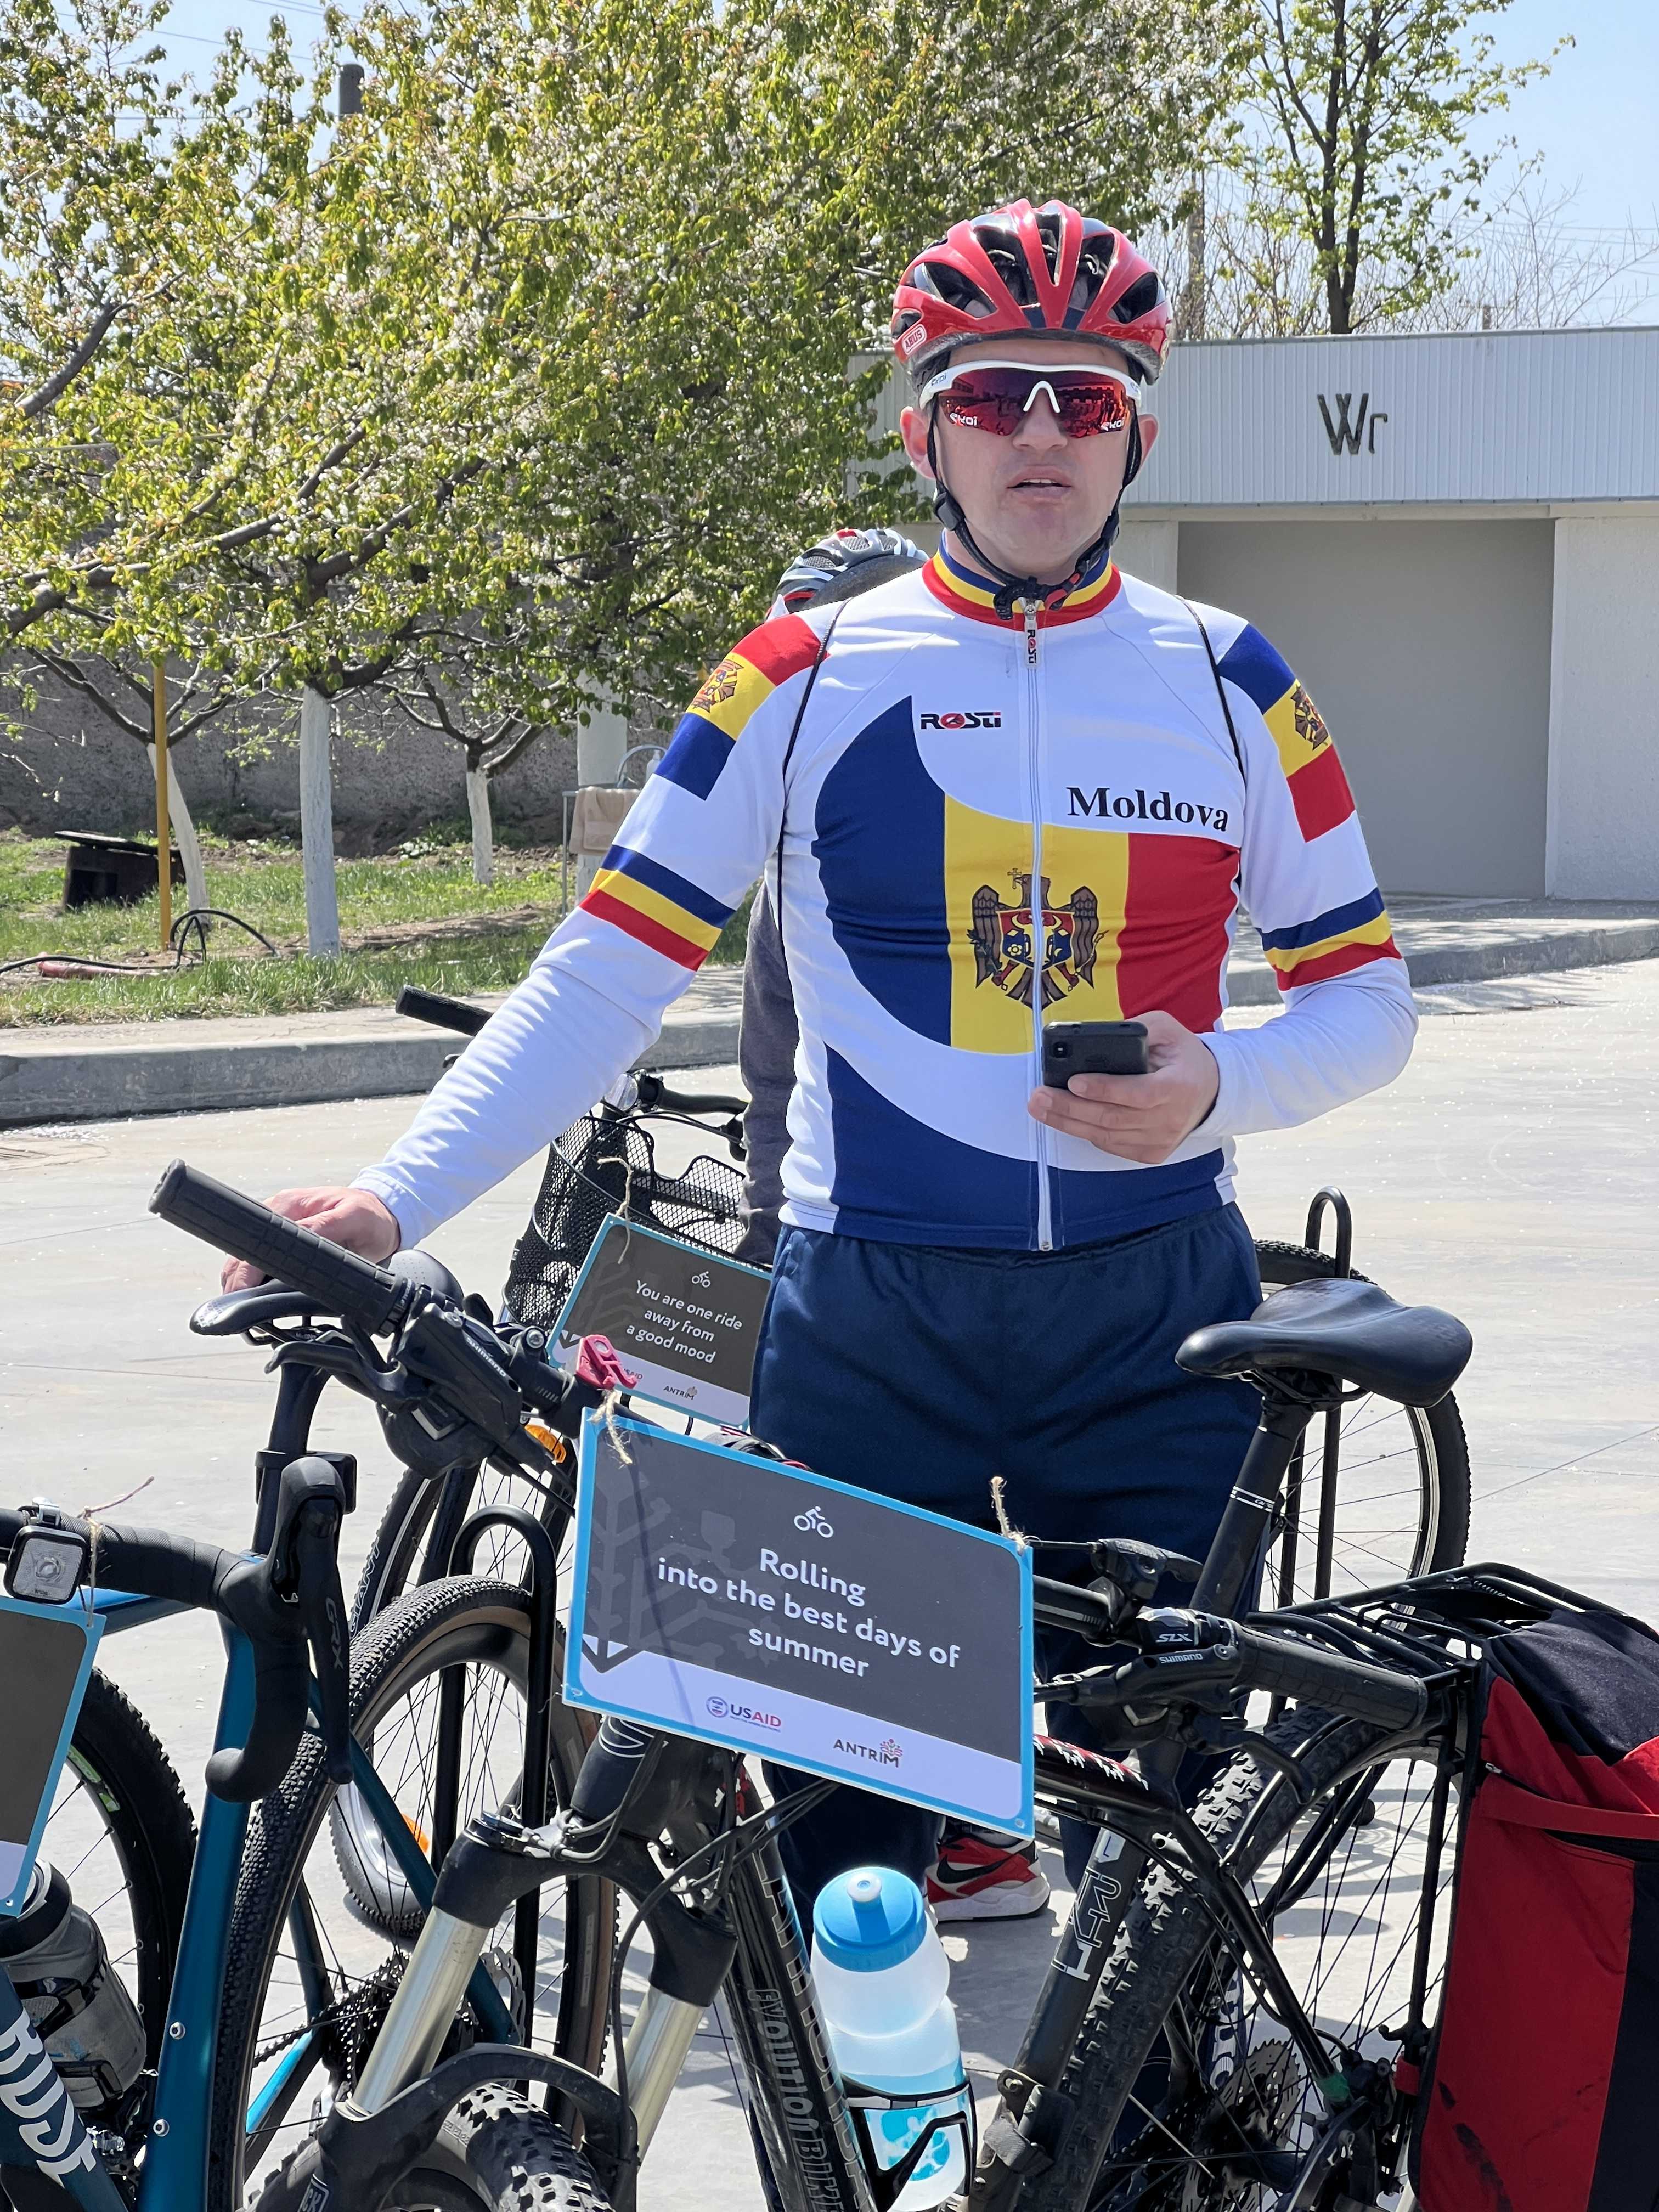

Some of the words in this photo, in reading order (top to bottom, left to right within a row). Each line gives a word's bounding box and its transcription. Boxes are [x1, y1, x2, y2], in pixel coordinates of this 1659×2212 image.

[904, 329, 923, 348] ABUS
[1066, 787, 1229, 833] Moldova
[636, 1280, 661, 1301] You
[662, 1295, 685, 1310] are
[686, 1304, 713, 1319] one
[715, 1312, 742, 1330] ride
[626, 1325, 635, 1335] a
[635, 1329, 675, 1349] good
[674, 1342, 716, 1363] mood
[644, 1310, 680, 1331] away
[681, 1320, 714, 1342] from
[466, 1337, 506, 1378] SHIMANO
[663, 1385, 695, 1401] ANTRIM
[760, 1548, 866, 1607] Rolling
[658, 1557, 718, 1594] into
[726, 1579, 776, 1611] the
[784, 1593, 848, 1634] best
[855, 1618, 922, 1656] days
[929, 1645, 961, 1668] of
[325, 1596, 343, 1670] GRX
[1155, 1633, 1193, 1643] SLX
[748, 1628, 869, 1677] summer
[1158, 1653, 1203, 1664] SHIMANO
[730, 1703, 782, 1728] USAID
[833, 1739, 902, 1769] ANTRIM
